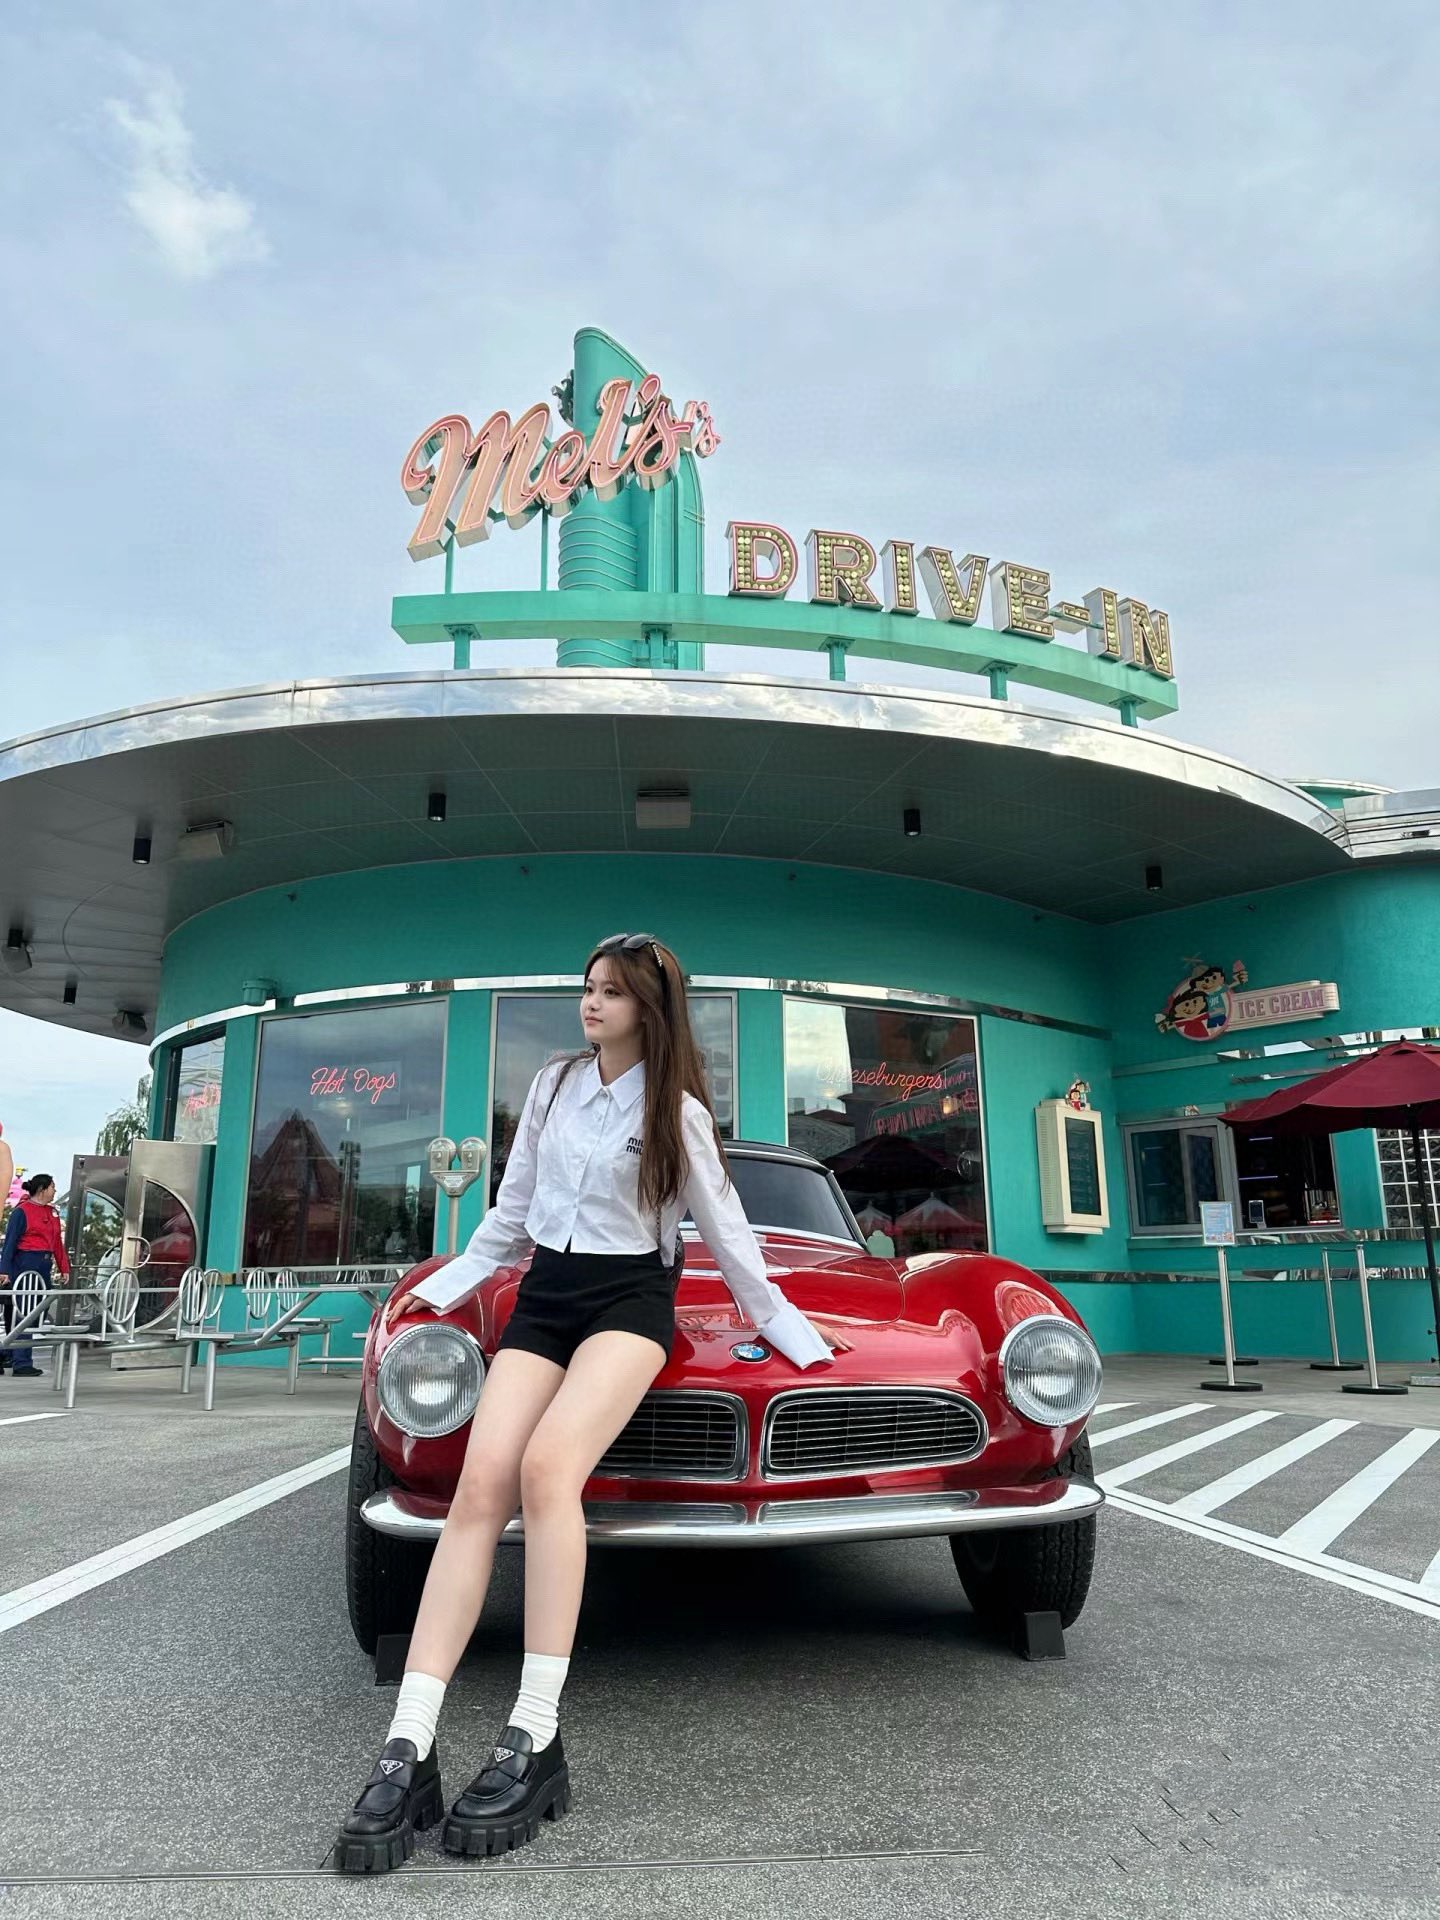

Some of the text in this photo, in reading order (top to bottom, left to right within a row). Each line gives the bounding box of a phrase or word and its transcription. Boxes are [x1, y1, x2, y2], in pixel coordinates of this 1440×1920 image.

[402, 373, 692, 560] Mel's
[726, 520, 1175, 681] DRIVE-IN
[1238, 989, 1325, 1019] ICE CREAM
[310, 1067, 395, 1105] Hot Dogs
